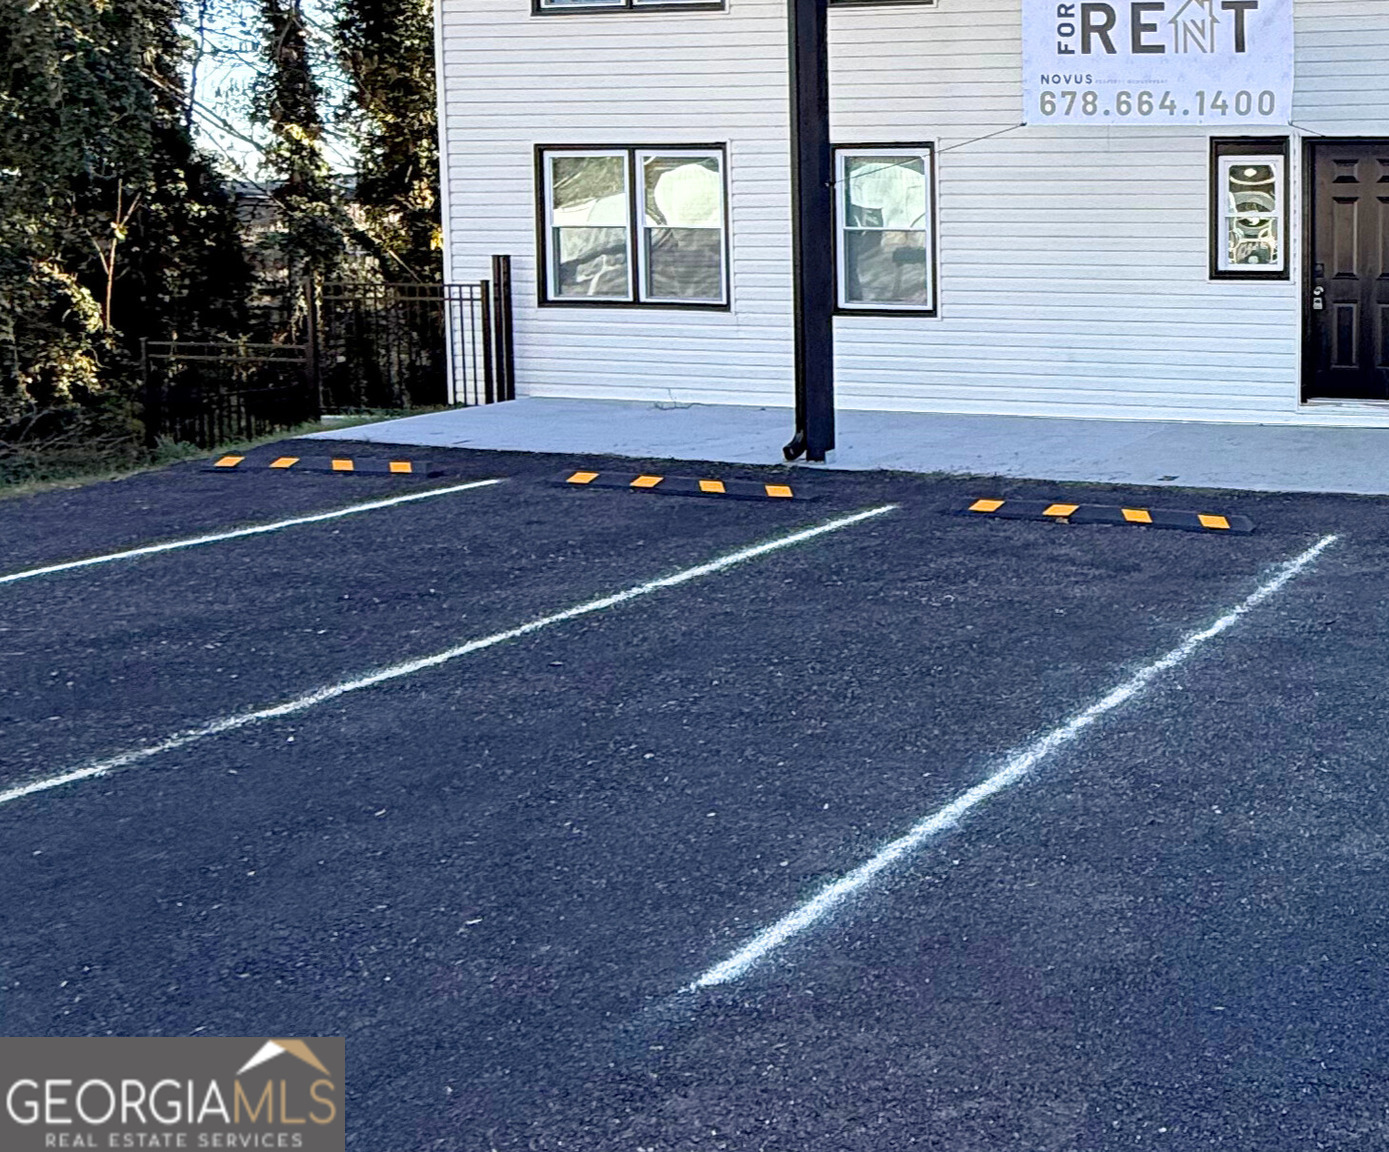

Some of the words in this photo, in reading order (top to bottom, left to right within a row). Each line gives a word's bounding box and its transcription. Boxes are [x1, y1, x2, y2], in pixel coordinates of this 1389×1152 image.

[1057, 3, 1075, 54] FOR
[1040, 74, 1093, 84] NOVUS
[1040, 90, 1275, 116] 678.664.1400
